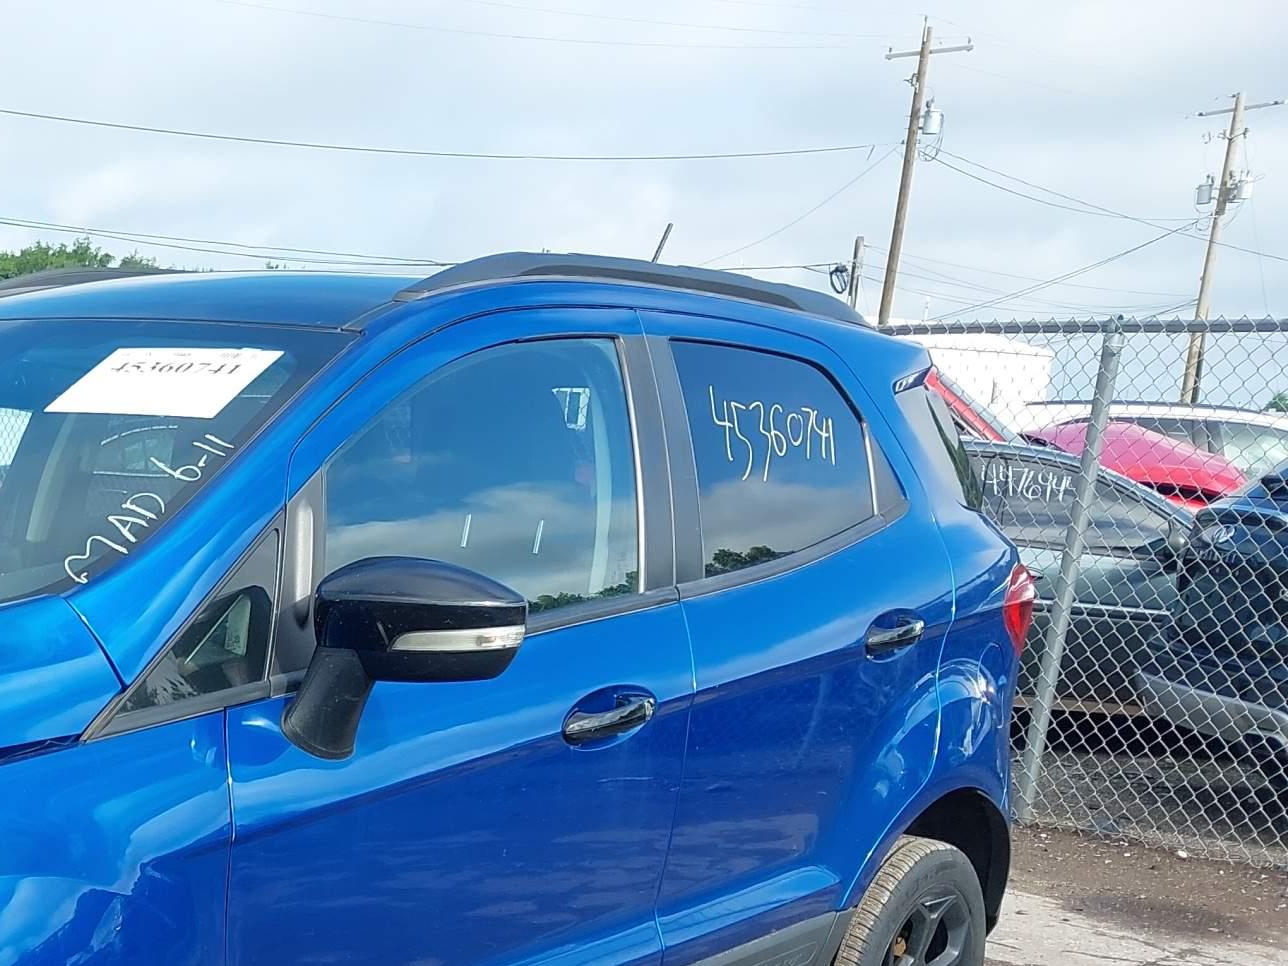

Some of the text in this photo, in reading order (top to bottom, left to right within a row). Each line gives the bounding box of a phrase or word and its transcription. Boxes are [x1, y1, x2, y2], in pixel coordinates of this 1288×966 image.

[709, 384, 836, 482] 45360741
[64, 492, 165, 584] MAD
[149, 433, 235, 482] 6-11
